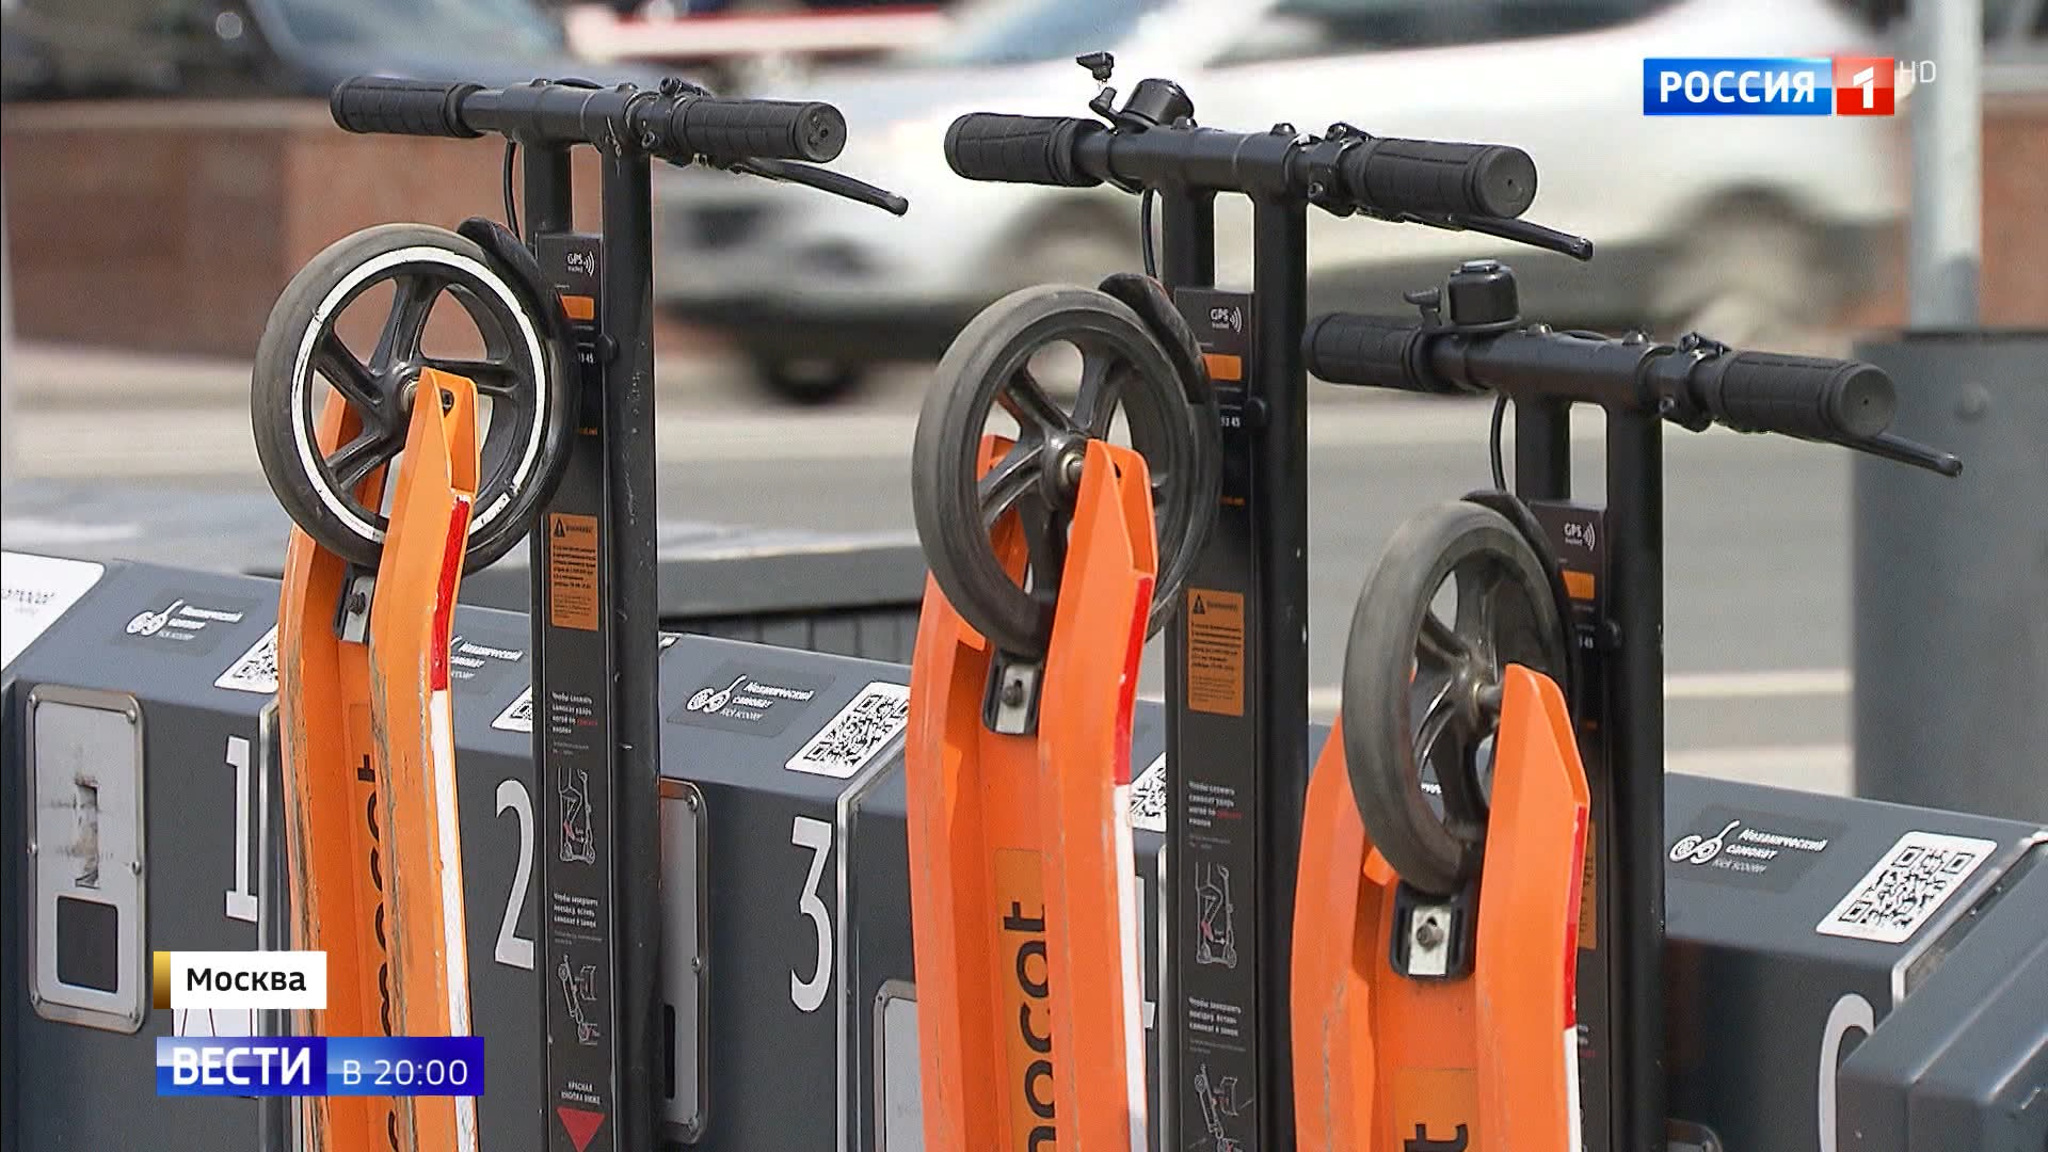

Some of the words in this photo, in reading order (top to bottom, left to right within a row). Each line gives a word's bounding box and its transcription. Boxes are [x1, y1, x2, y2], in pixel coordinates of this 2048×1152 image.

[567, 253, 583, 266] GPS
[1210, 308, 1230, 321] GPS
[1564, 523, 1582, 538] GPS
[225, 735, 258, 922] 1
[495, 779, 535, 970] 2
[791, 816, 833, 1013] 3
